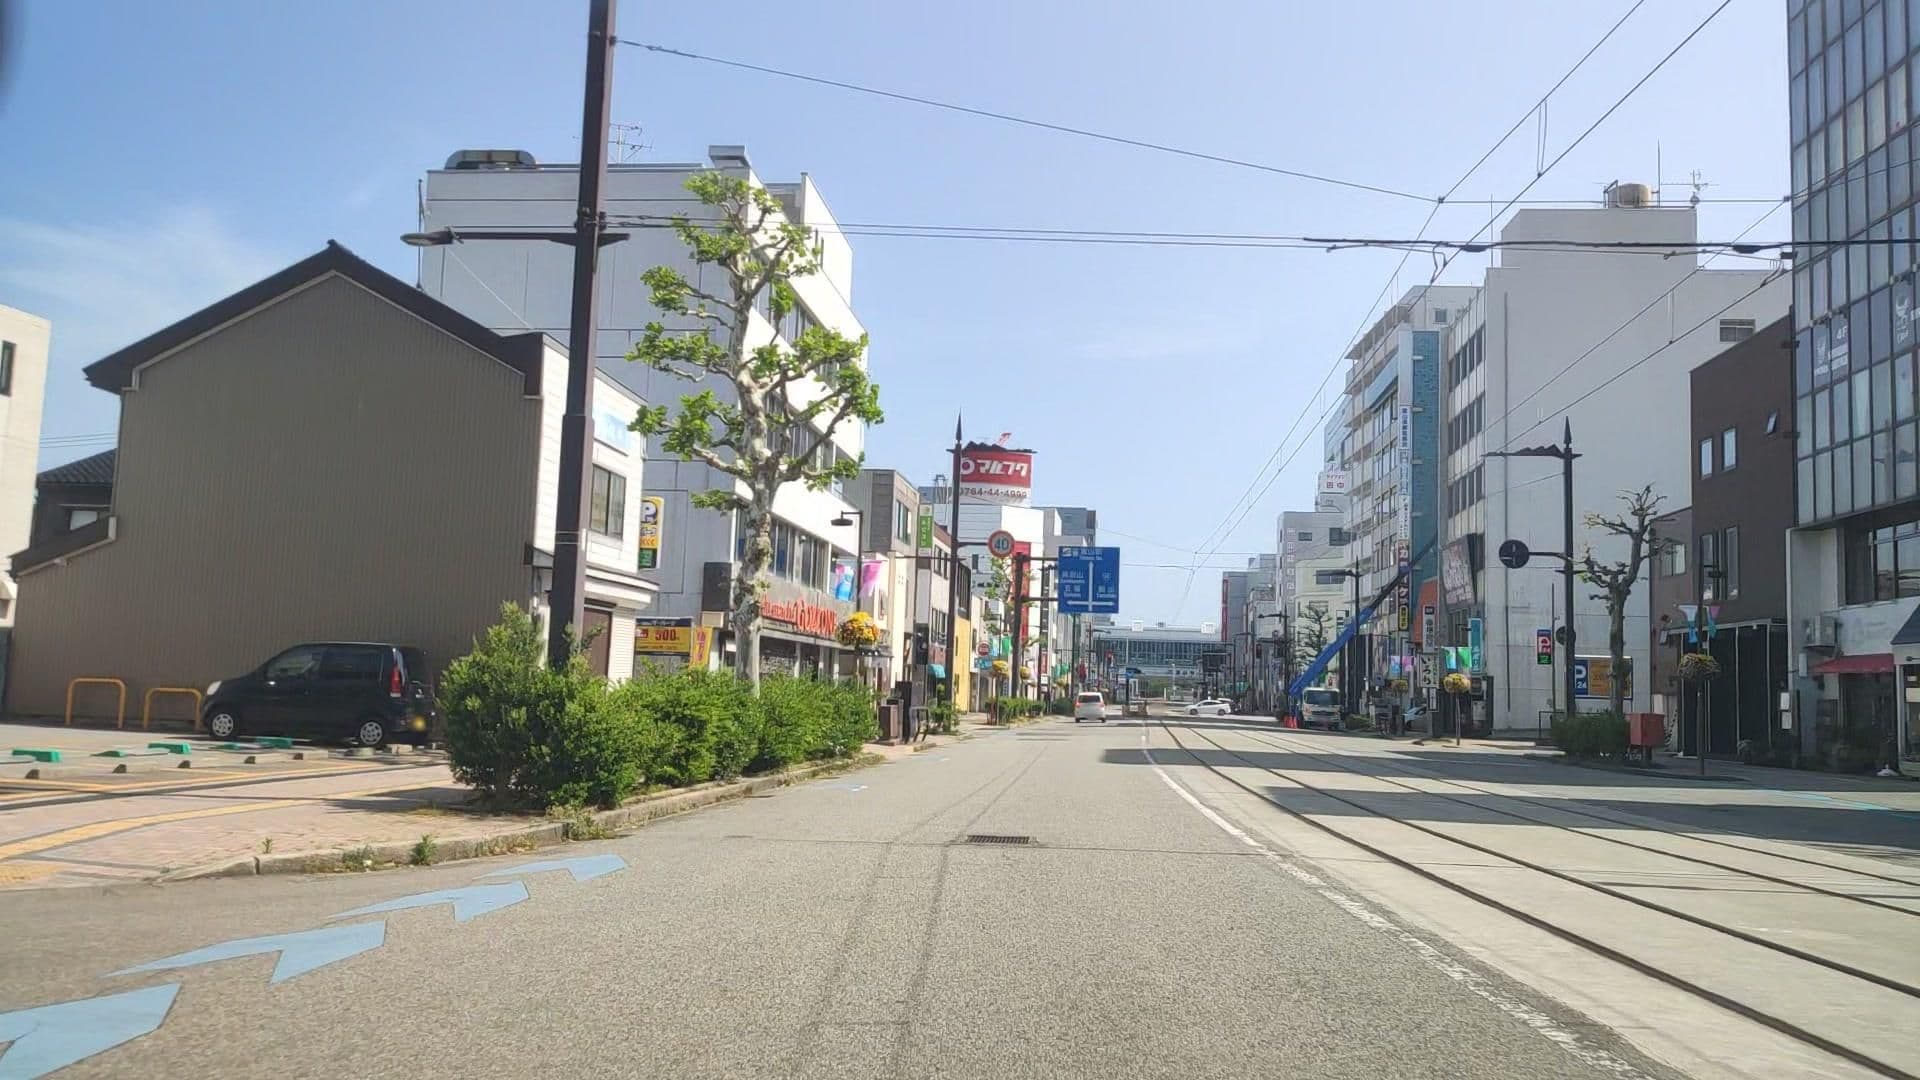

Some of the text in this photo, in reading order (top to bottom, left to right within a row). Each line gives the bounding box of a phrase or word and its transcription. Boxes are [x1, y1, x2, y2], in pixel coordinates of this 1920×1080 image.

[977, 459, 1028, 477] マルフク
[994, 537, 1009, 550] 40
[655, 629, 676, 641] 500
[1539, 637, 1551, 652] P
